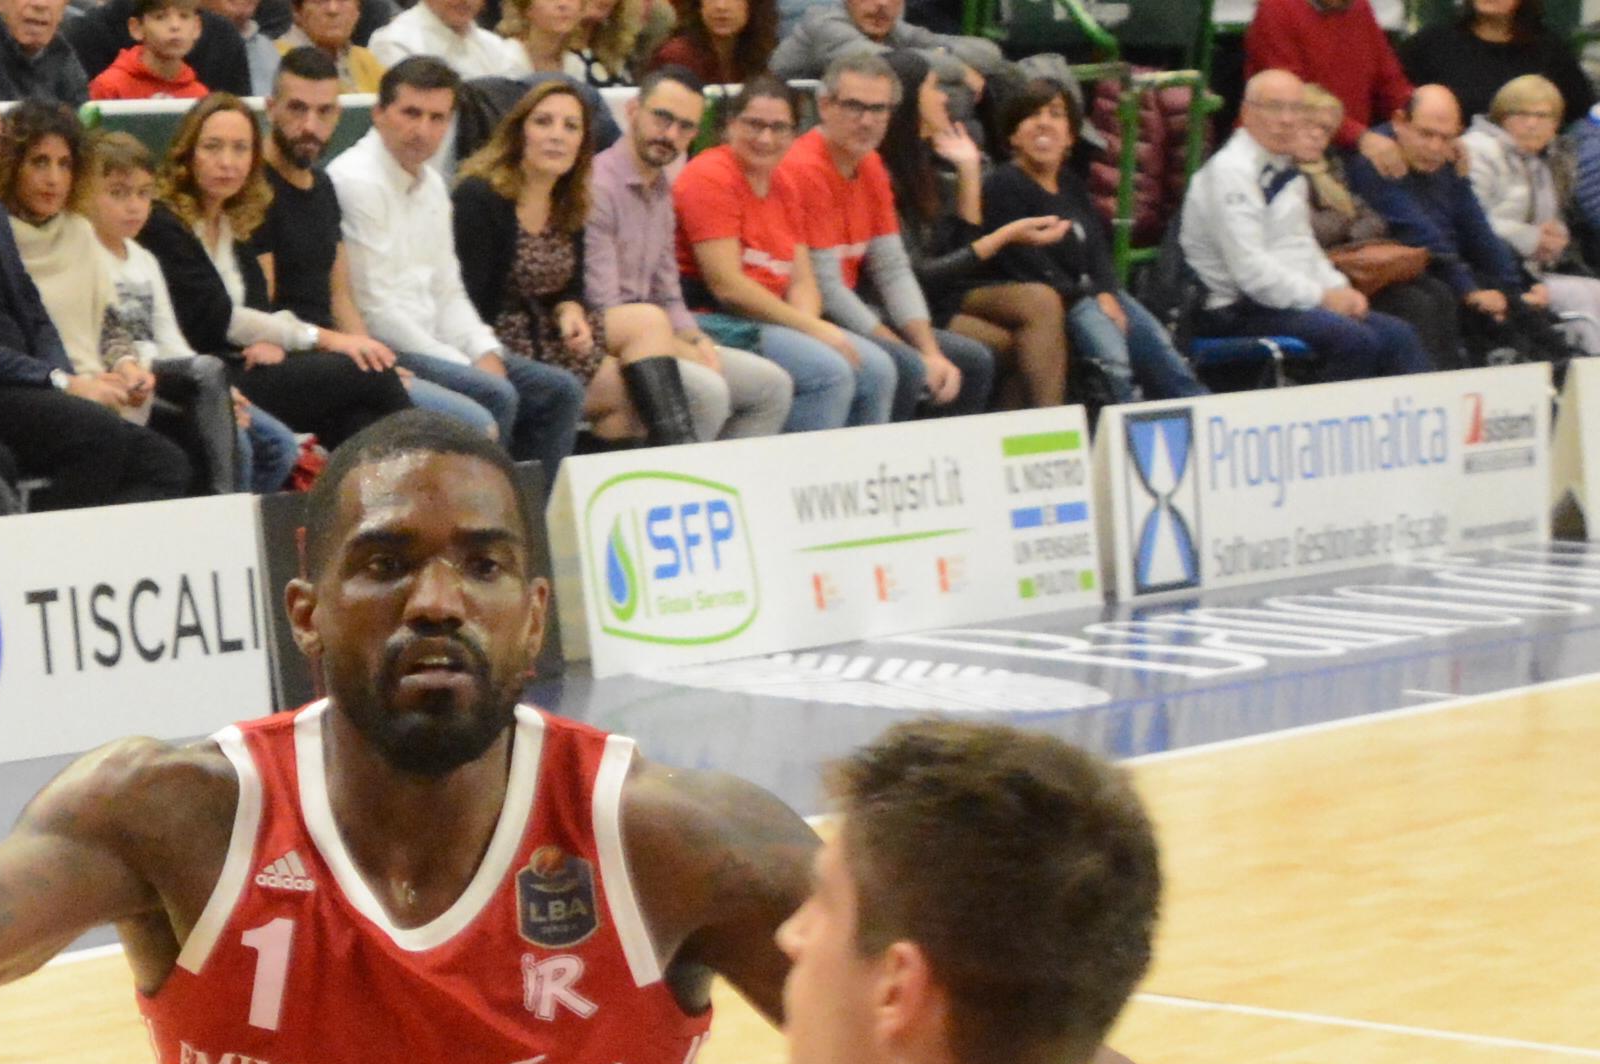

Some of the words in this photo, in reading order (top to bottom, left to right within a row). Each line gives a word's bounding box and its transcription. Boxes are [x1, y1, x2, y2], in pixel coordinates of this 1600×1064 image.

[1208, 397, 1447, 508] Programmatica
[646, 499, 734, 580] SFP
[1212, 535, 1291, 578] Software
[25, 566, 261, 676] TISCALI
[255, 873, 315, 892] adidas
[530, 898, 588, 923] LBA
[240, 917, 295, 1031] 1
